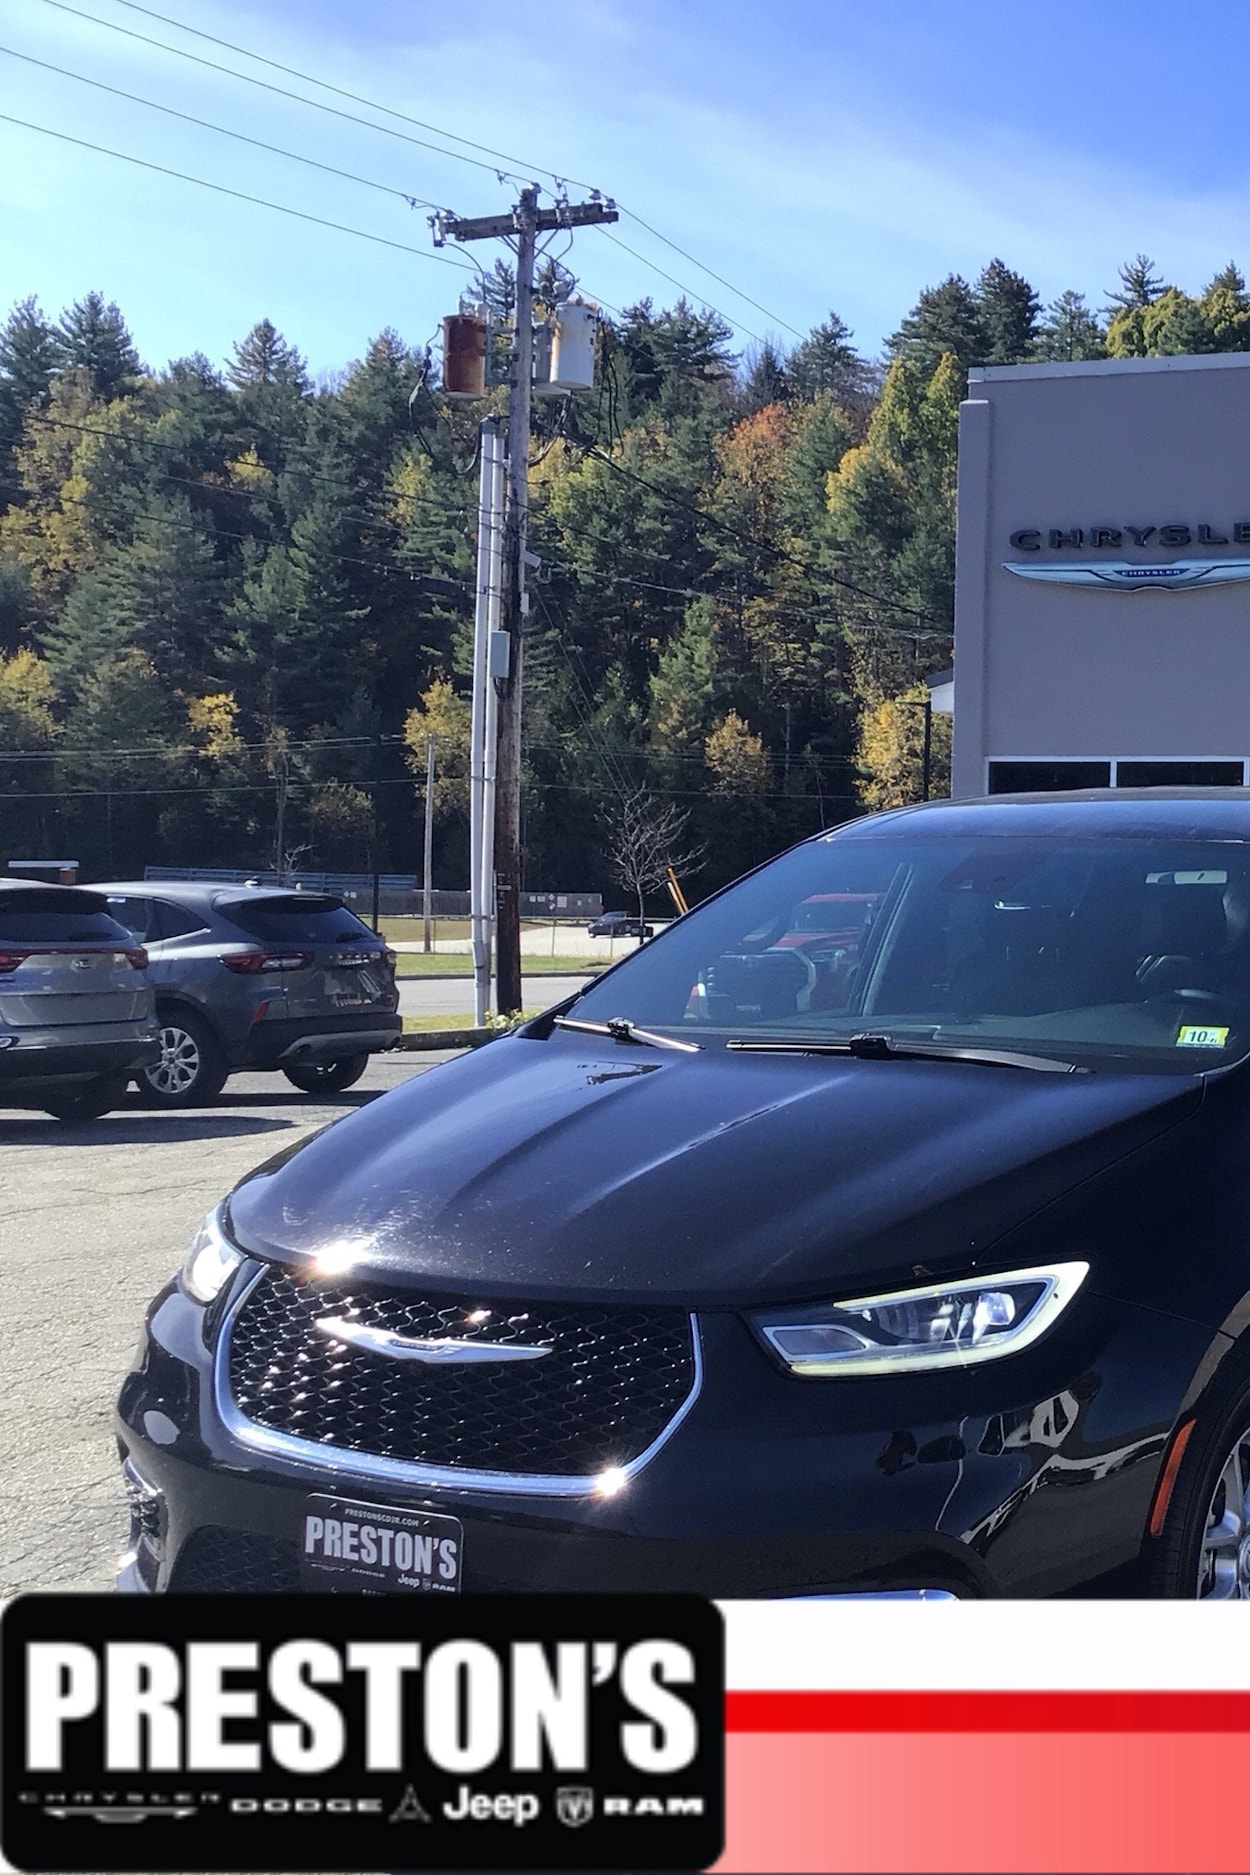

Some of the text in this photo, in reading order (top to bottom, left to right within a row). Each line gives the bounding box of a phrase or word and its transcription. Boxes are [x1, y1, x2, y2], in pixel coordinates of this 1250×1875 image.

[1121, 569, 1181, 577] CHRYSLER
[1190, 1031, 1208, 1043] 10
[344, 1508, 420, 1527] PRESTONSCDJR.COM
[305, 1516, 457, 1580] PRESTON'S
[397, 1573, 420, 1589] Jeep
[431, 1582, 456, 1593] RAM
